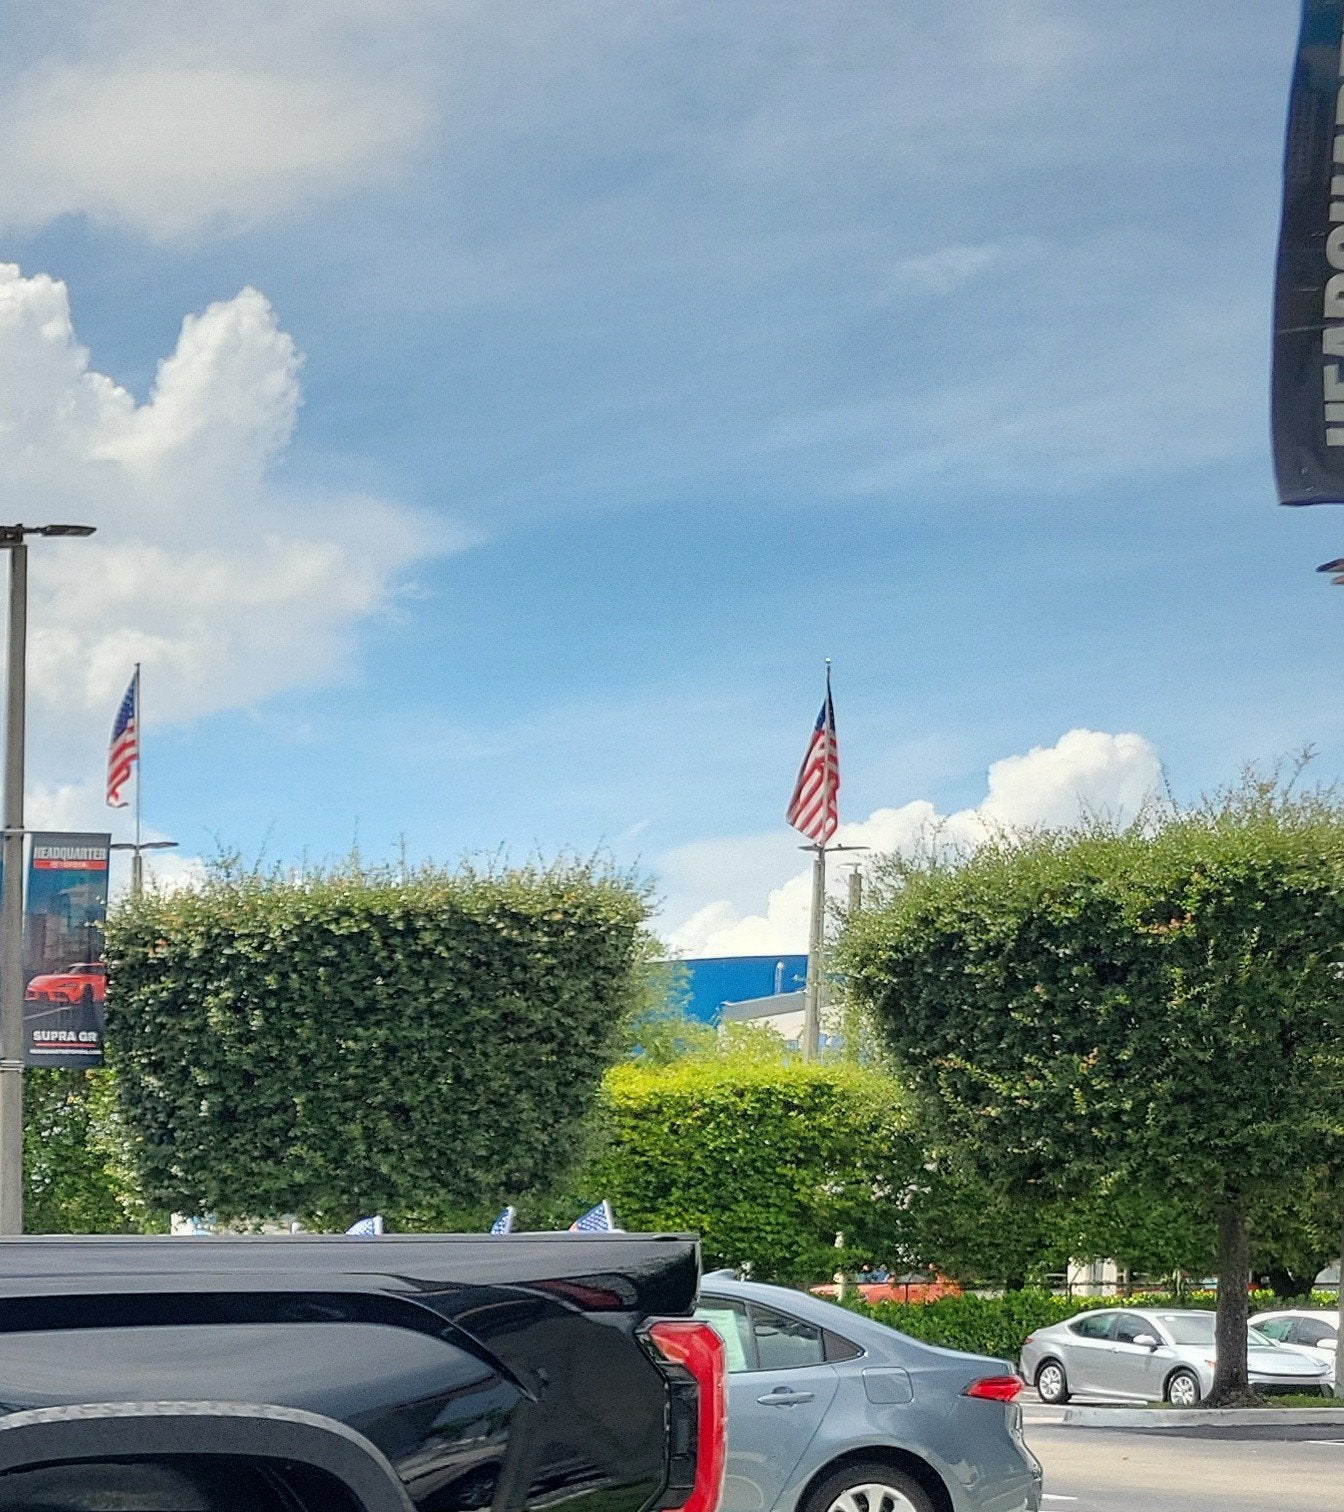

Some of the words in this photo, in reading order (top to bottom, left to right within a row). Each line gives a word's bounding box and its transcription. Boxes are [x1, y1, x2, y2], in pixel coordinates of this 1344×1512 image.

[34, 847, 106, 860] HEADQUARTER
[33, 1030, 77, 1042] SUPRA
[78, 1031, 98, 1042] GR
